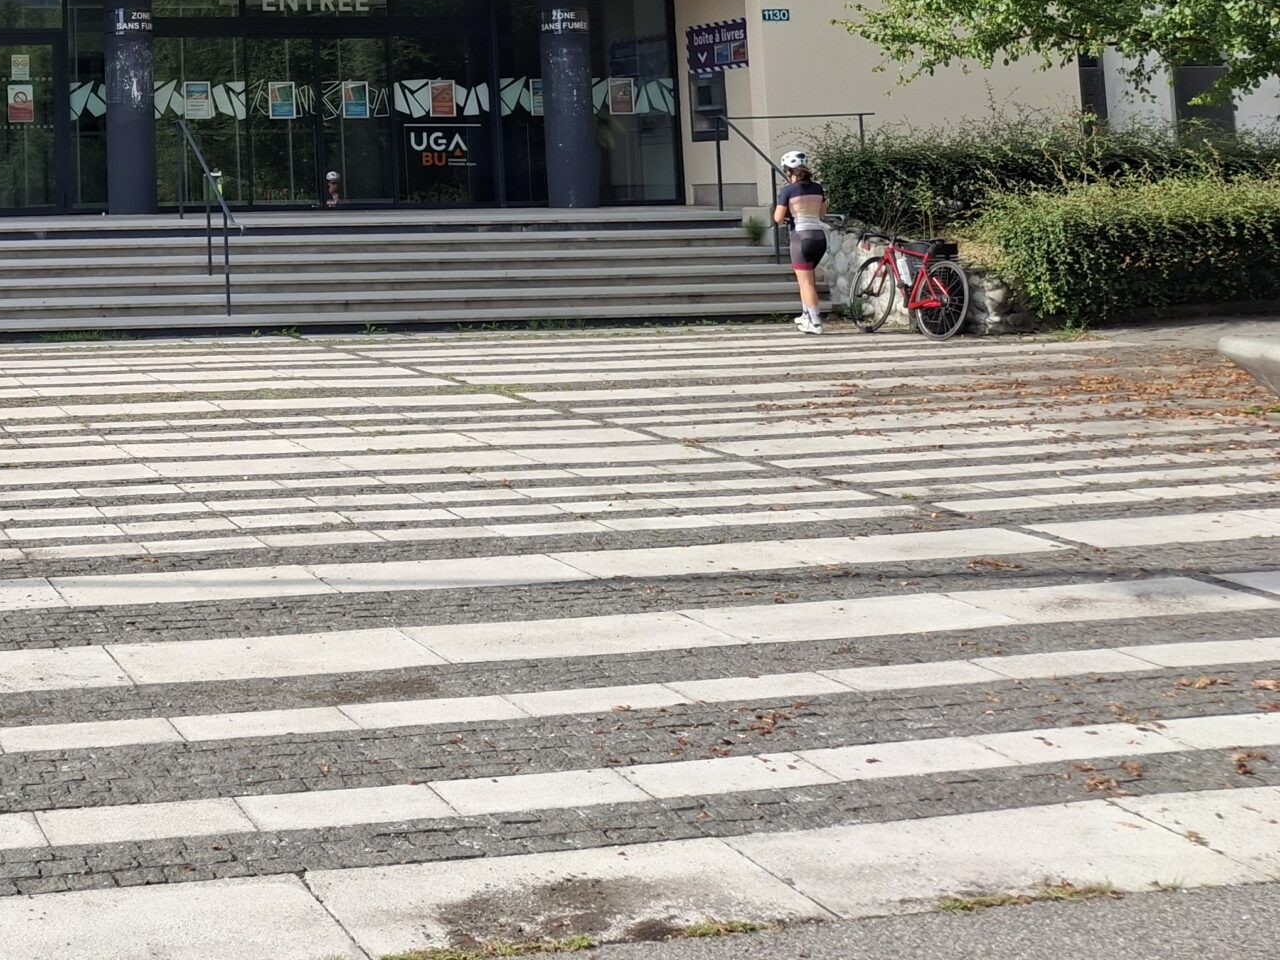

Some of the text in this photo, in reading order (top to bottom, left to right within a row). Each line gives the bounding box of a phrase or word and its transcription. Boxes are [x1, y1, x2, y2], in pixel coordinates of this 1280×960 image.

[131, 11, 151, 20] ZONE
[552, 11, 576, 20] ZONE
[763, 10, 789, 20] 1130
[116, 22, 139, 30] SANS
[541, 22, 561, 31] SANS
[693, 27, 745, 46] boîte à livres
[410, 131, 468, 151] UGA
[422, 152, 447, 166] BU
